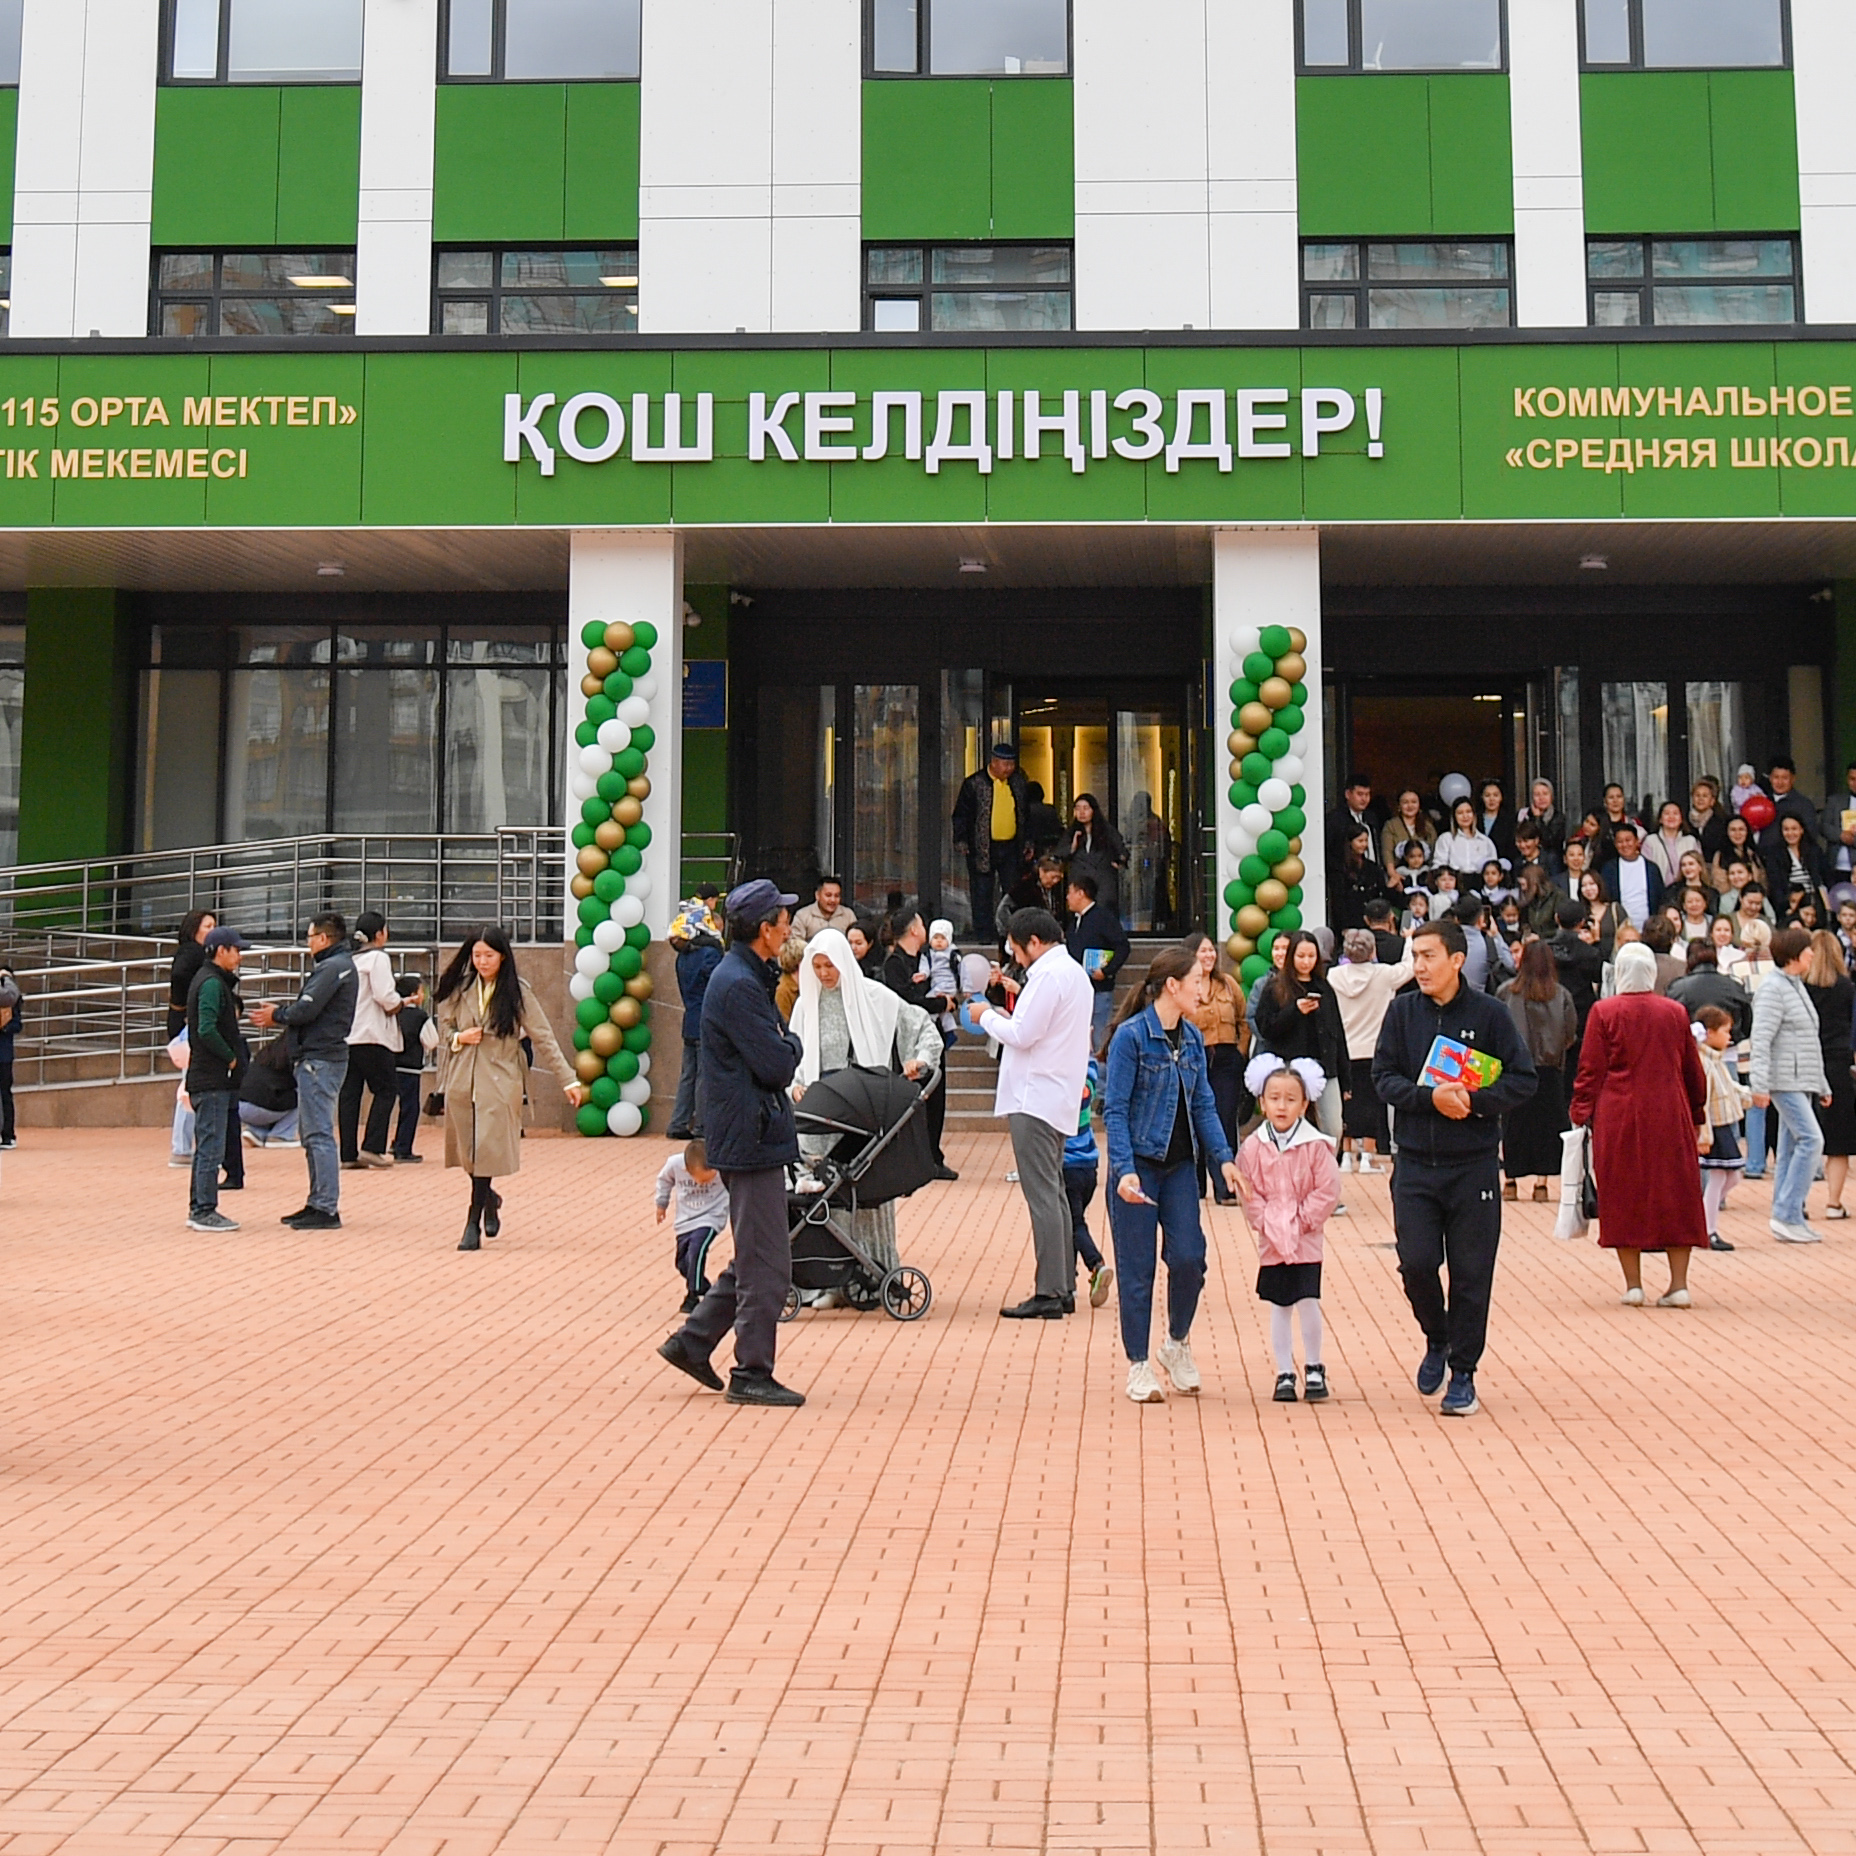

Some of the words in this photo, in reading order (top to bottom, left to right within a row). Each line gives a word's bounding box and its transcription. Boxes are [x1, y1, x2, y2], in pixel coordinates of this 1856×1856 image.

[70, 396, 170, 427] ОРТА
[183, 396, 357, 426] МЕКТЕП»
[1512, 384, 1854, 419] КОММУНАЛЬНОЕ
[504, 392, 713, 476] ҚОШ
[748, 388, 1384, 474] КЕЛДІҢІЗДЕР!
[50, 447, 247, 479] МЕКЕМЕСІ
[1505, 438, 1717, 475] «СРЕДНЯЯ
